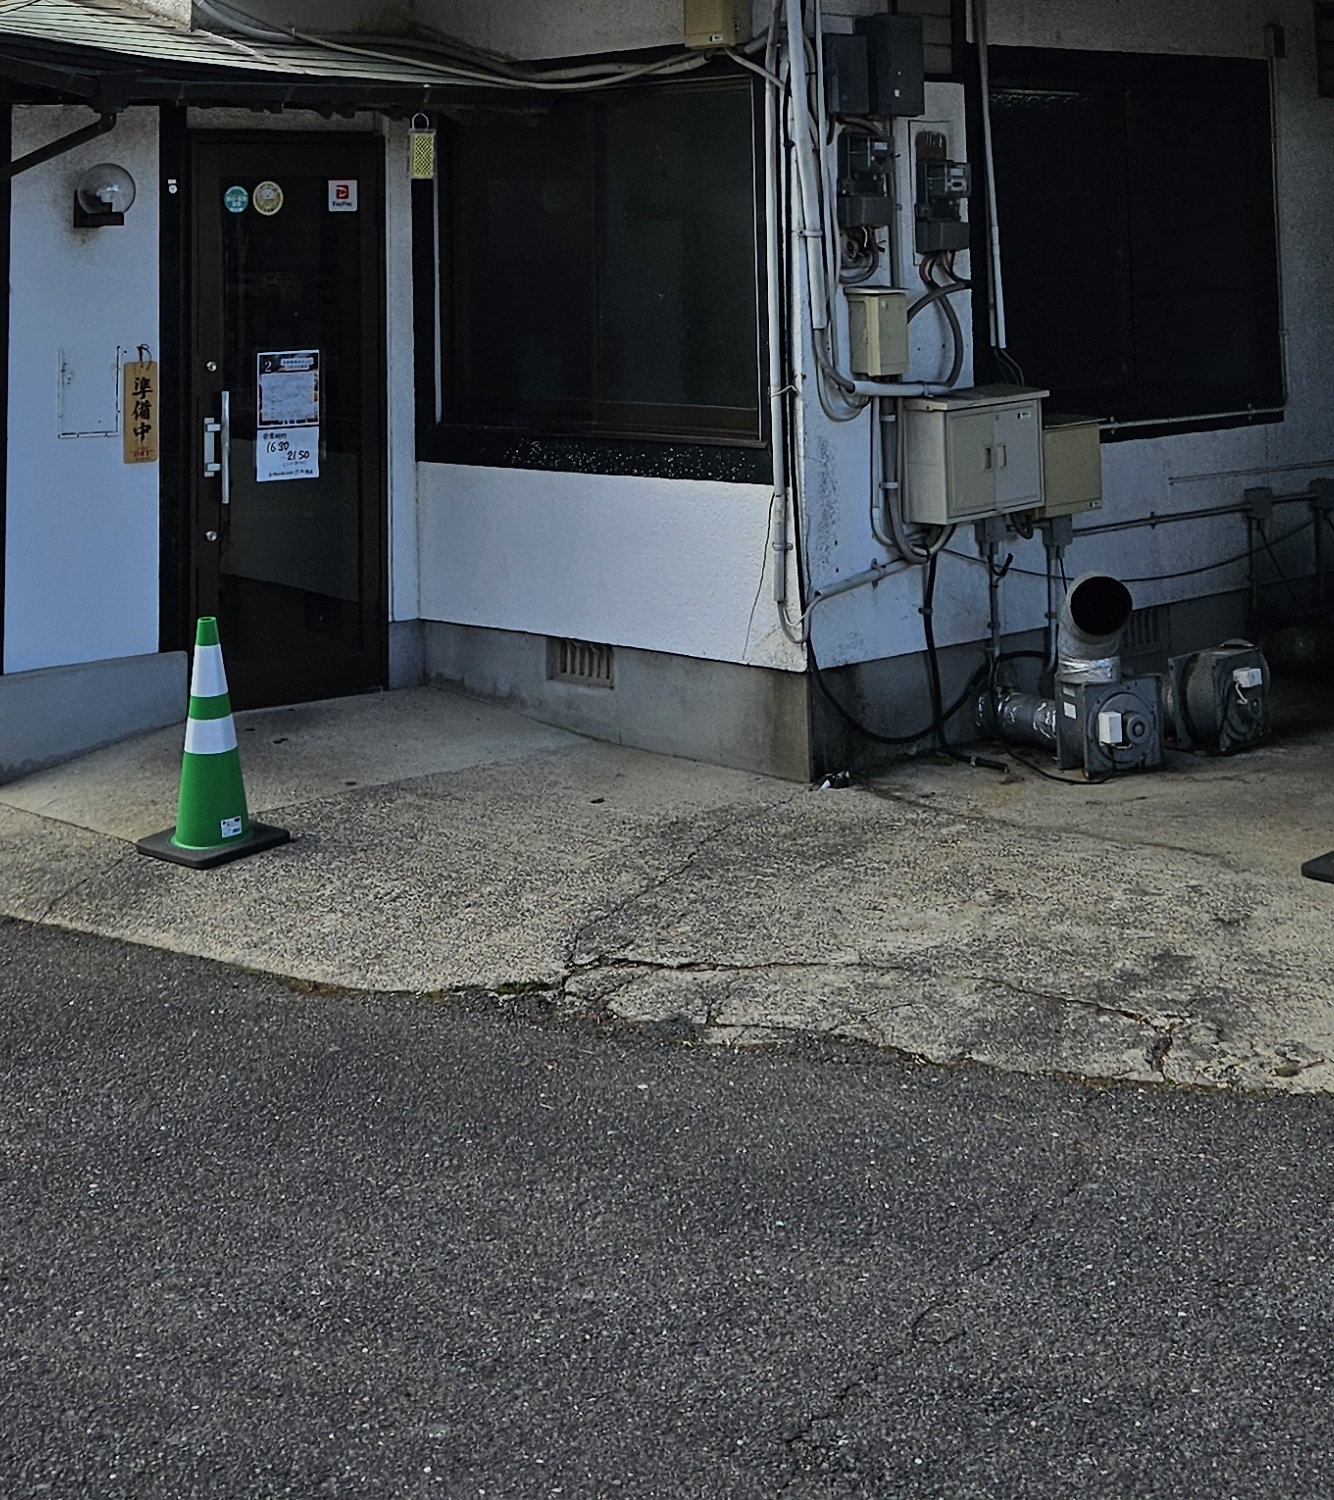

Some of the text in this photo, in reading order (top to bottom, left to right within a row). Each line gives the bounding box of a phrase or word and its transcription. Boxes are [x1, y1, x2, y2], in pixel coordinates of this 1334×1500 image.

[264, 360, 272, 372] 2
[132, 377, 154, 442] 準備中
